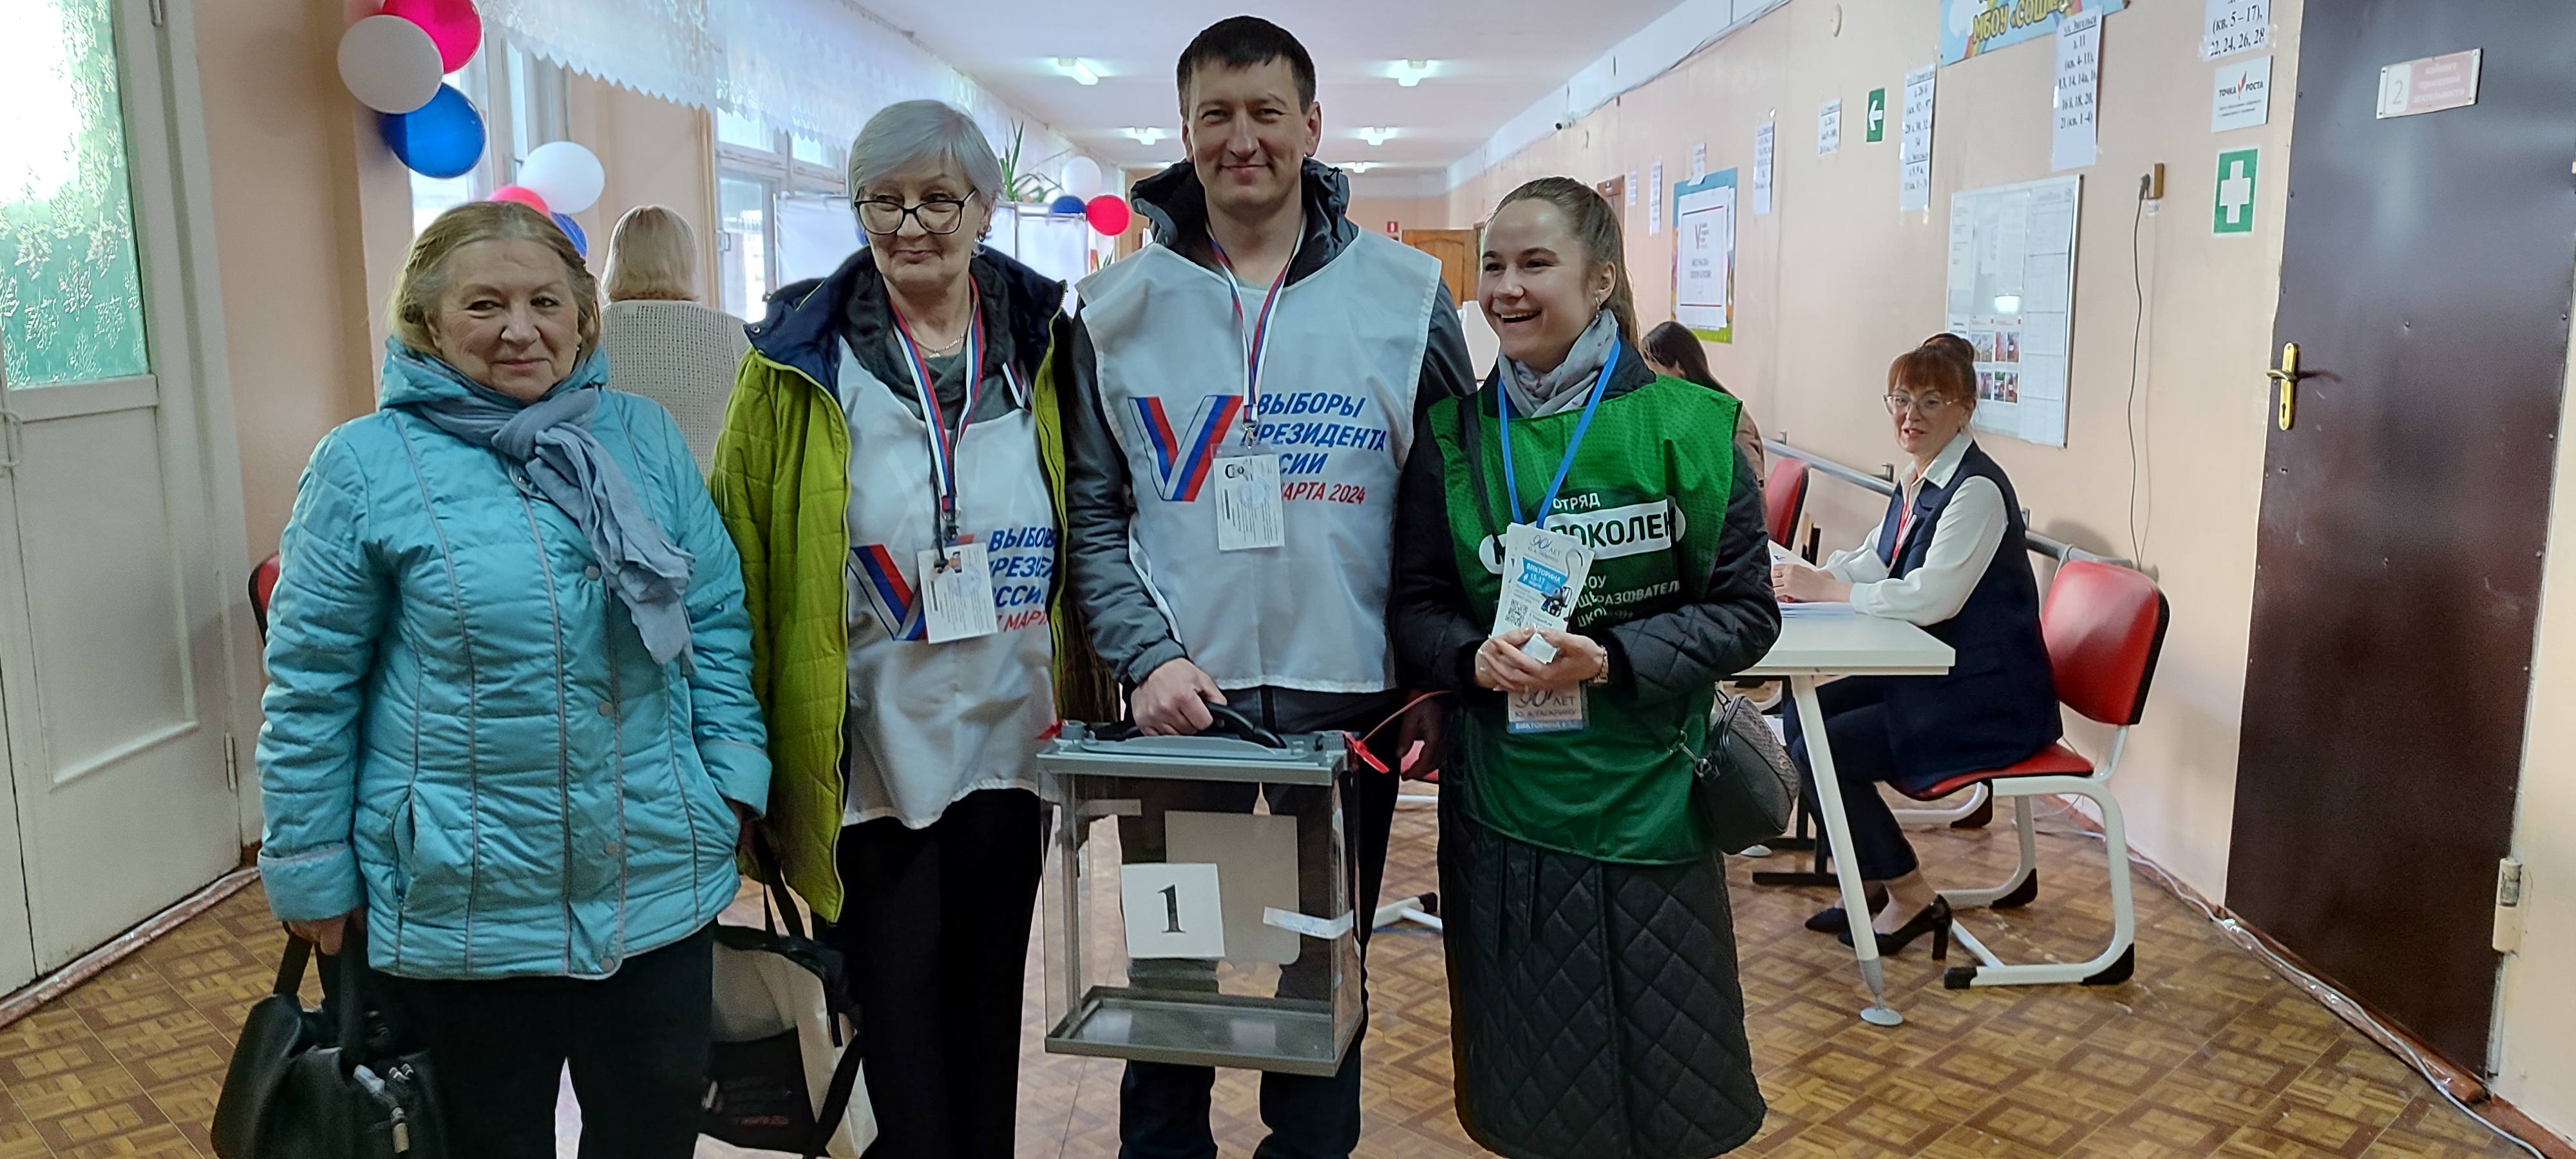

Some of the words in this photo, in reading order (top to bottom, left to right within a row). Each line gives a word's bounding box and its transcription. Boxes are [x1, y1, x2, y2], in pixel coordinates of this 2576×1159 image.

[1972, 3, 2009, 44] МБОУ
[2213, 17, 2228, 34] (кв.
[2230, 11, 2236, 26] 5
[2223, 35, 2235, 53] 24,
[2238, 32, 2251, 49] 26,
[2253, 27, 2265, 44] 28
[2219, 86, 2236, 97] ТОЧКА
[2246, 80, 2263, 91] РОСТА
[2392, 79, 2403, 105] 2
[1258, 392, 1366, 418] ВЫБОРЫ
[1280, 453, 1329, 475] СИИ
[1282, 482, 1326, 500] АРТА
[1328, 484, 1366, 505] 2024
[1553, 493, 1601, 511] ОТРЯД
[1527, 563, 1561, 583] ВИКТОРИНА
[1553, 696, 1576, 706] ЛЕТ
[1157, 884, 1186, 934] 1
